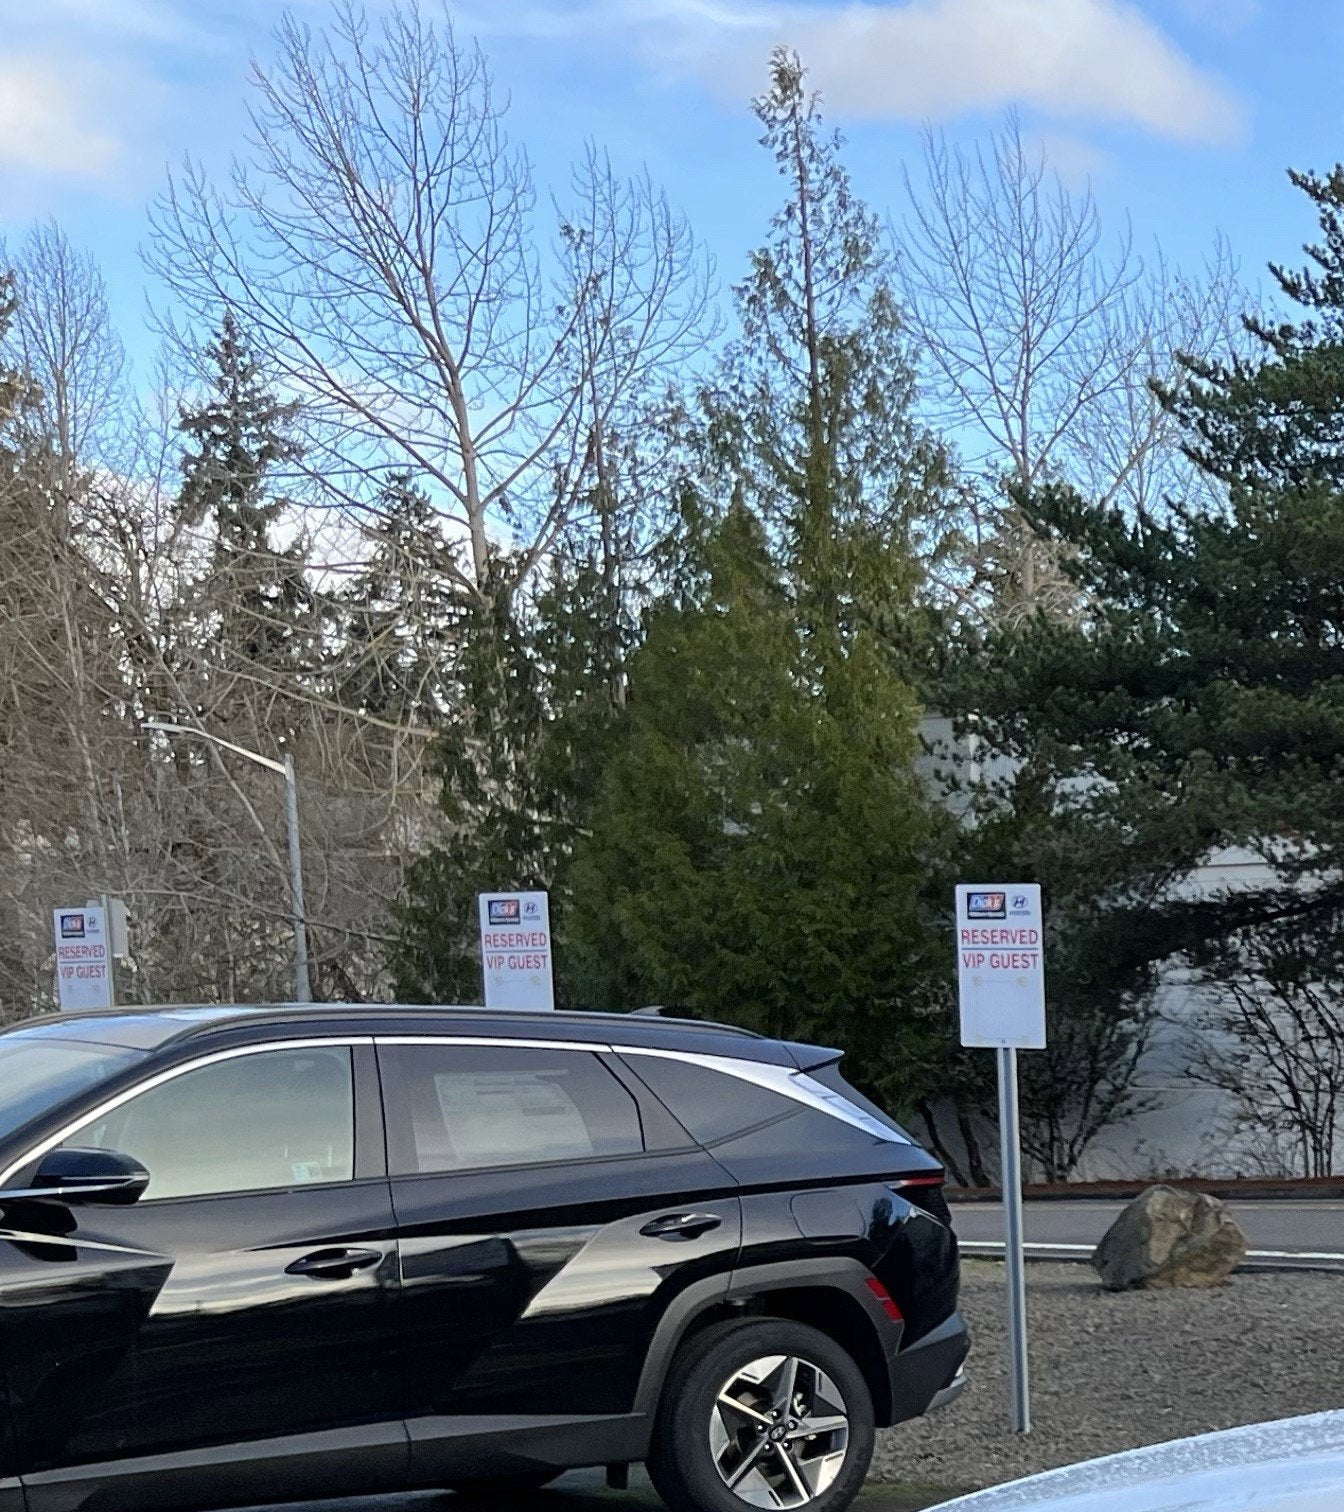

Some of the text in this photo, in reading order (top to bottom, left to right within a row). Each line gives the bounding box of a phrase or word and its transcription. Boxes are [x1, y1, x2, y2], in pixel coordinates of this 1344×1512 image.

[484, 932, 547, 948] RESERVED
[960, 929, 1039, 945] RESERVED
[58, 945, 105, 959] RESERVED
[486, 955, 548, 970] VIP GUEST
[962, 953, 1039, 969] VIP GUEST
[60, 965, 106, 979] VIP GUEST
